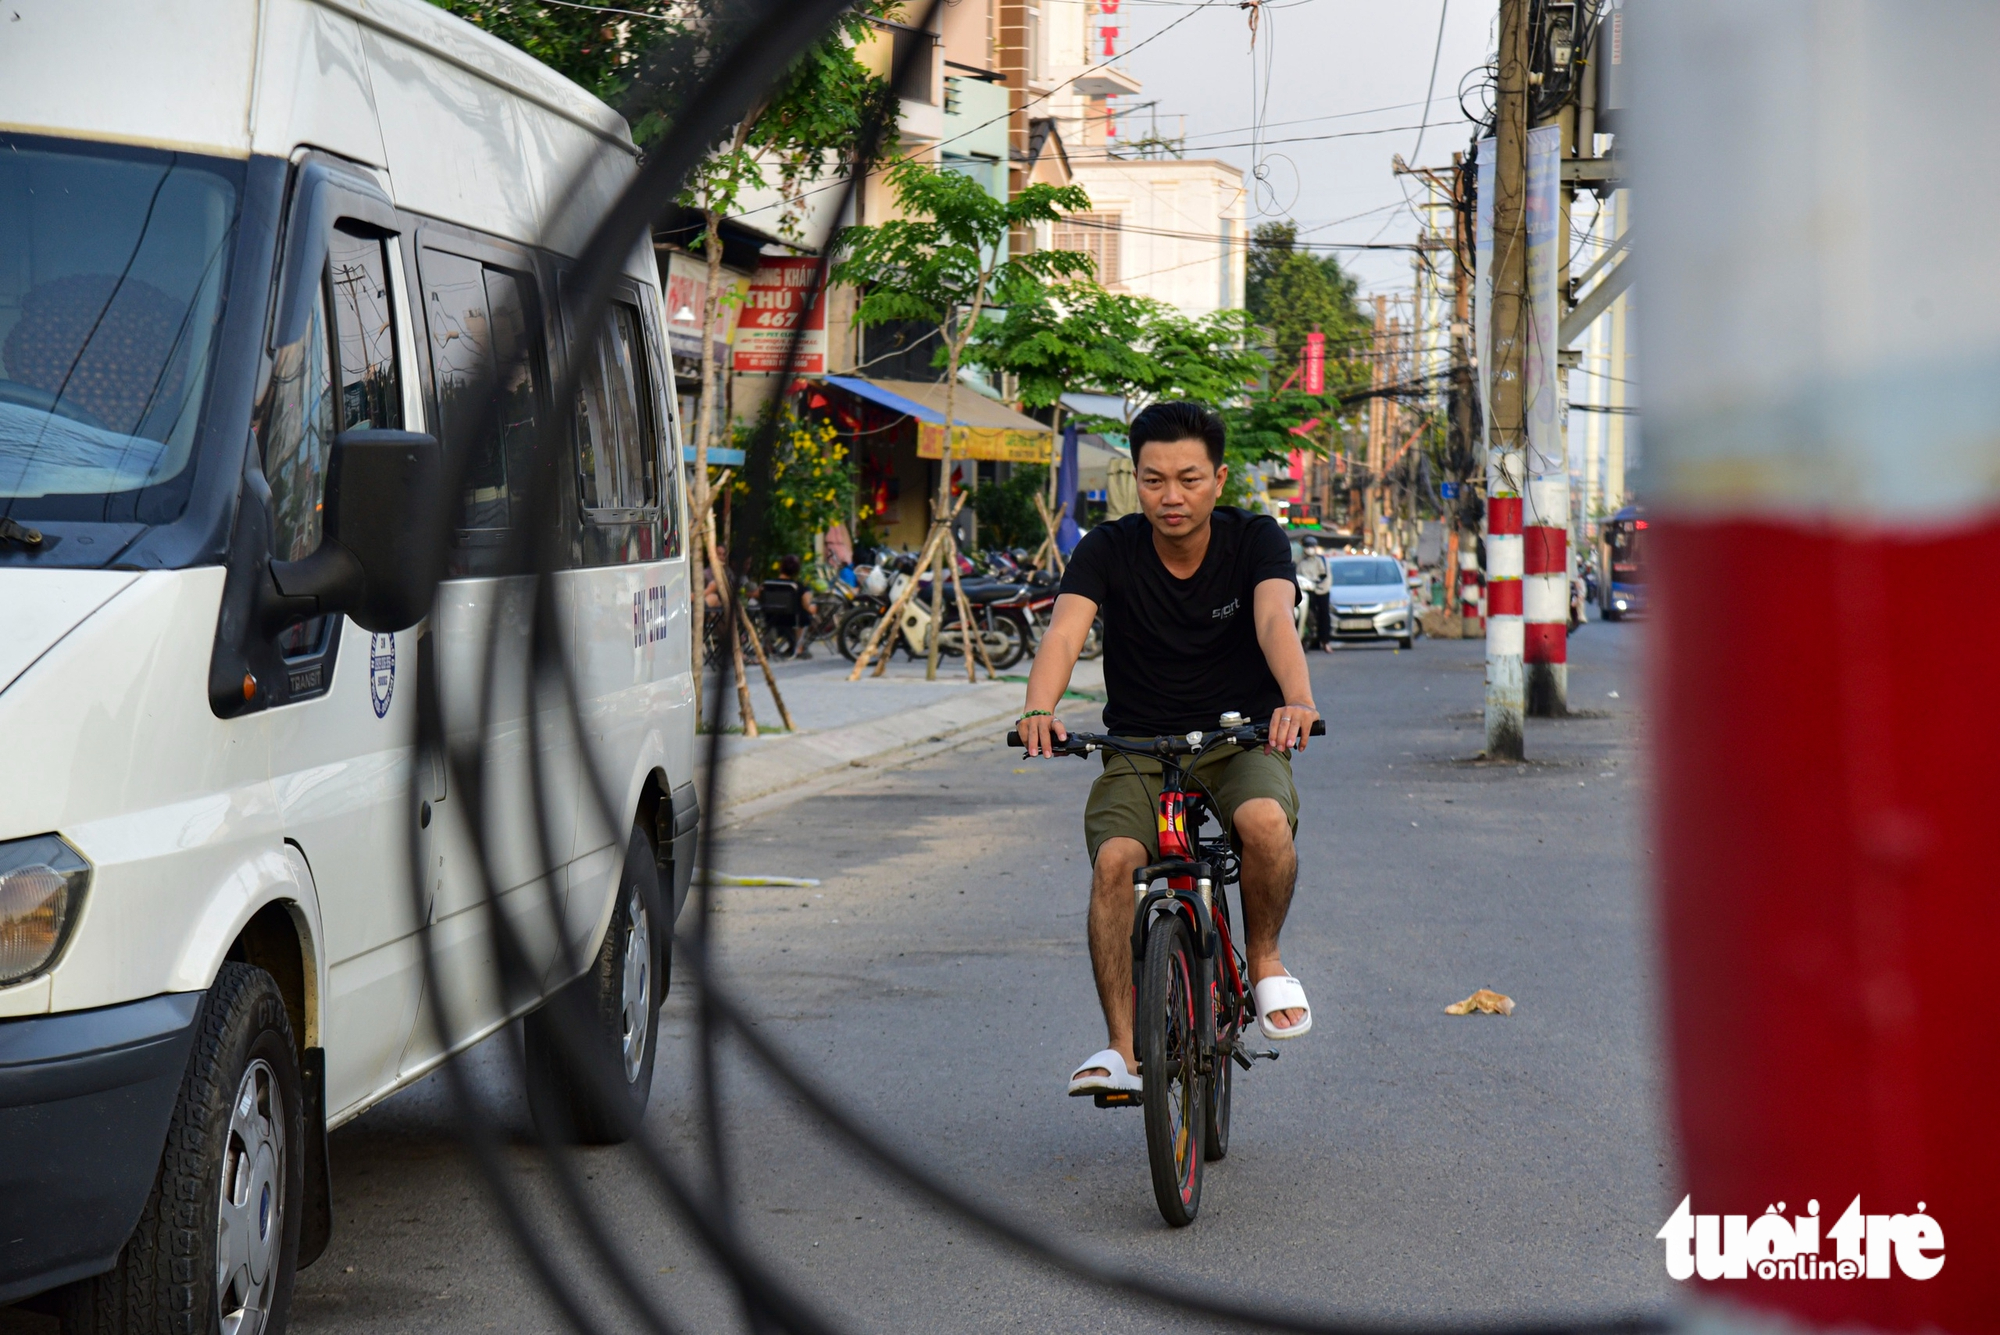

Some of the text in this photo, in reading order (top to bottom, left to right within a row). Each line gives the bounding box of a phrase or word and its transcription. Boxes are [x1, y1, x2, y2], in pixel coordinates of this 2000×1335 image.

[757, 312, 798, 327] 467
[1212, 598, 1240, 620] sport
[290, 671, 321, 691] TRANSIT
